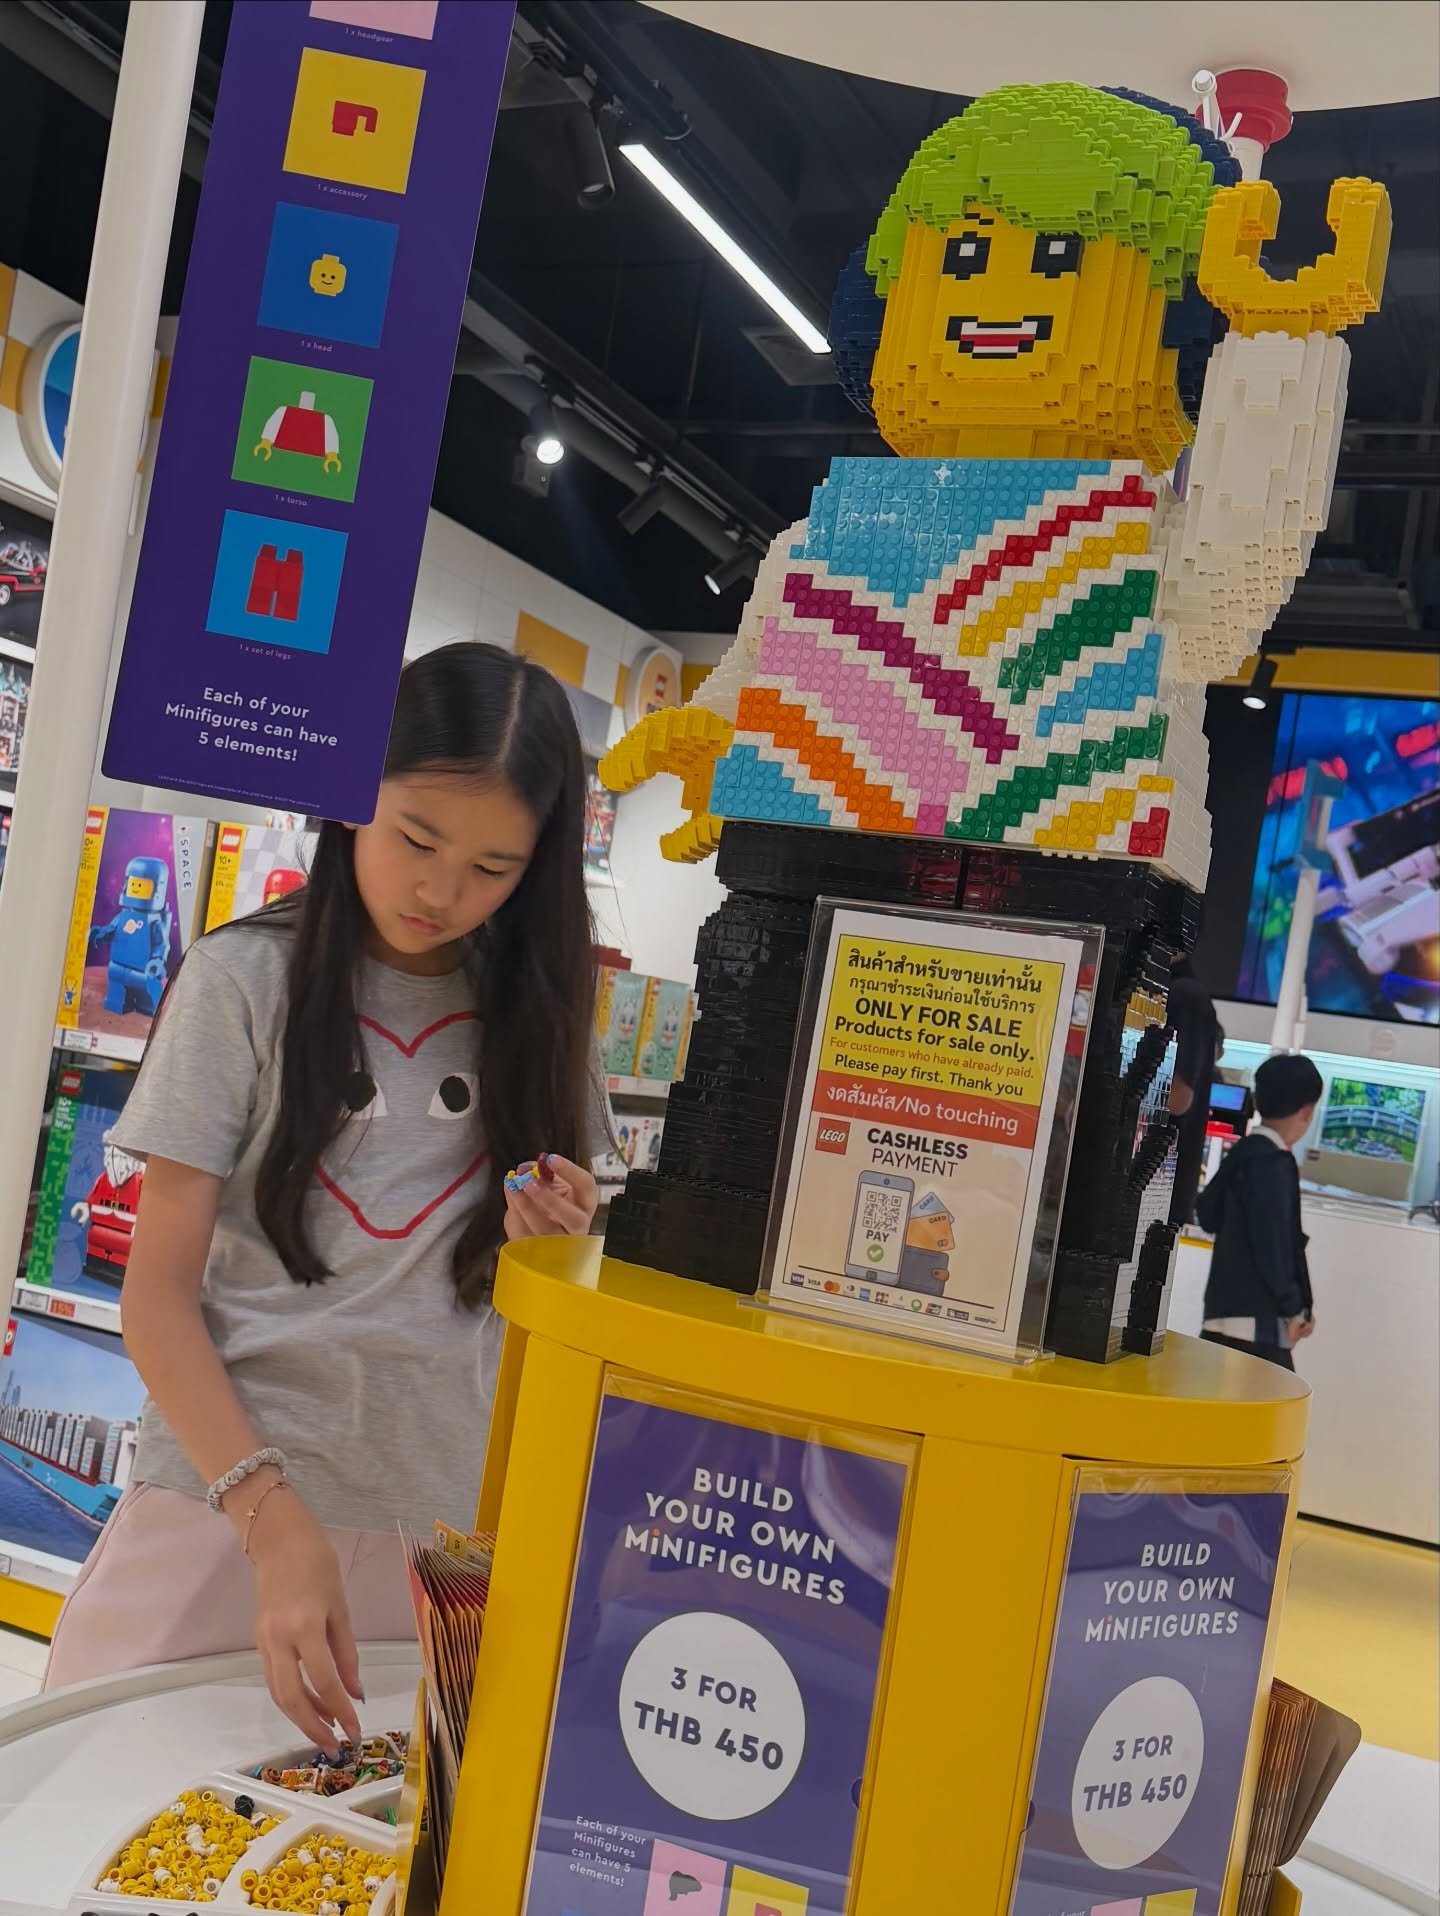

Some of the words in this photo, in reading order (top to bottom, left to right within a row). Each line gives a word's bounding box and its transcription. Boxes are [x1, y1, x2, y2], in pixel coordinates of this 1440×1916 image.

[357, 30, 394, 43] headgear
[329, 187, 368, 200] accessory
[313, 342, 332, 352] head
[287, 497, 307, 507] torso
[251, 646, 263, 655] set
[265, 649, 274, 657] of
[275, 650, 291, 661] legs
[203, 688, 243, 707] Each
[249, 697, 268, 711] of
[269, 702, 310, 719] your
[165, 703, 258, 732] Minifigures
[263, 724, 294, 739] can
[298, 726, 338, 747] have
[198, 732, 209, 745] 5
[214, 735, 298, 762] elements!
[180, 839, 192, 888] SPACE
[848, 948, 1042, 993] สินค้าสำหรับขายเท่านั้น
[849, 976, 1036, 1014] กรุณาชำระเงินก่อนใช้บริการ
[855, 997, 914, 1021] ONLY
[918, 1006, 961, 1030] FOR
[966, 1014, 1023, 1038] SALE
[834, 1015, 913, 1042] Products
[917, 1029, 945, 1047] for
[948, 1035, 985, 1054] sale
[989, 1041, 1035, 1062] only.
[830, 1037, 848, 1048] For
[850, 1041, 906, 1058] customers
[908, 1051, 931, 1063] who
[933, 1053, 960, 1067] have
[962, 1059, 1003, 1075] already
[1006, 1066, 1034, 1080] paid.
[834, 1053, 880, 1073] Please
[881, 1065, 908, 1080] pay
[910, 1067, 944, 1084] first.
[949, 1072, 993, 1093] Thank
[996, 1081, 1024, 1097] you
[826, 1084, 931, 1117] งดสัมผัส/No
[935, 1105, 1020, 1137] touching
[819, 1129, 846, 1144] LEGO
[867, 1128, 969, 1161] CASHLESS
[871, 1147, 958, 1178] PAYMENT
[928, 1215, 947, 1225] CARD
[866, 1229, 890, 1243] PAY
[807, 1277, 822, 1288] VISA
[693, 1467, 794, 1513] BUILD
[645, 1492, 735, 1538] YOUR
[751, 1520, 836, 1564] OWN
[1140, 1542, 1211, 1568] BUILD
[1103, 1579, 1169, 1605] YOUR
[1178, 1576, 1236, 1602] OWN
[670, 1666, 688, 1691] 3
[698, 1674, 758, 1713] FOR
[634, 1700, 702, 1746] THB
[714, 1727, 784, 1771] 450
[1112, 1739, 1126, 1762] 3
[1131, 1734, 1174, 1760] FOR
[1083, 1781, 1133, 1812] THB
[1140, 1773, 1188, 1804] 450
[573, 1831, 636, 1859] Minifigures
[575, 1815, 602, 1832] Each
[606, 1825, 619, 1835] of
[620, 1832, 647, 1846] your
[569, 1863, 625, 1888] elements!
[571, 1847, 592, 1860] can
[594, 1853, 622, 1870] have
[623, 1863, 631, 1873] 5
